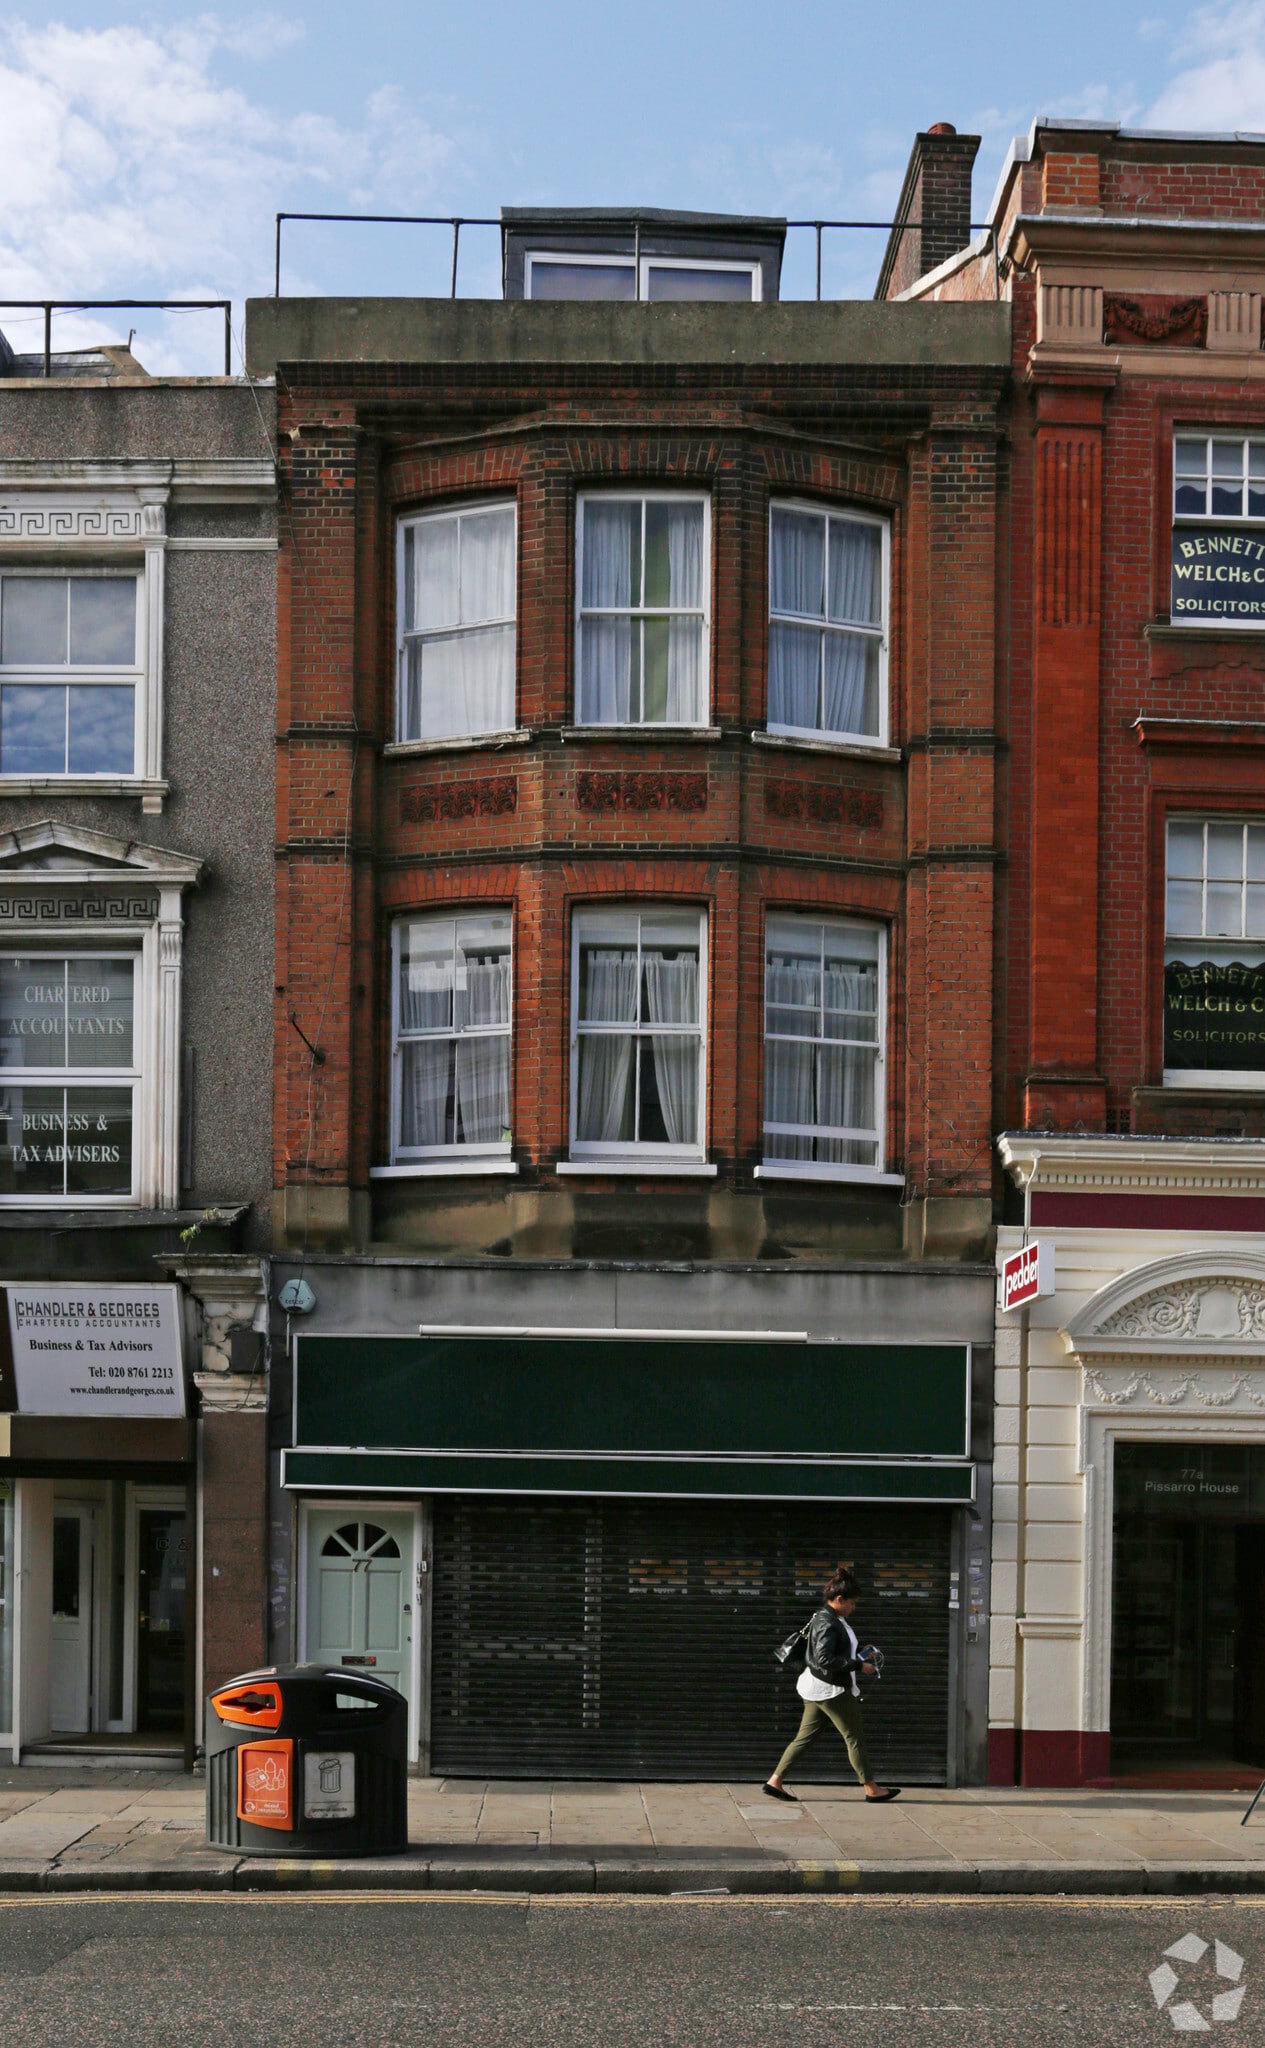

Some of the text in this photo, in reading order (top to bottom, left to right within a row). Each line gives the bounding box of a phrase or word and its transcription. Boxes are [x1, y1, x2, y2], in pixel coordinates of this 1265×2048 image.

[1180, 536, 1265, 560] BENNETT
[24, 986, 110, 1003] CHARERED
[96, 1114, 108, 1131] &
[10, 1145, 120, 1162] TAX ADVISERS
[16, 1301, 160, 1318] CHANDLER & GEORGES
[18, 1319, 162, 1329] CHARTERED ACCOUNTANTS
[29, 1339, 153, 1352] Business & Tax Advisors
[88, 1366, 174, 1379] Tel: 020 8761 2213
[70, 1386, 175, 1397] www.chandlerandgeorges.co.uk
[1181, 1469, 1204, 1480] 77a
[1145, 1481, 1240, 1493] Pissarro House
[352, 1559, 372, 1572] 77
